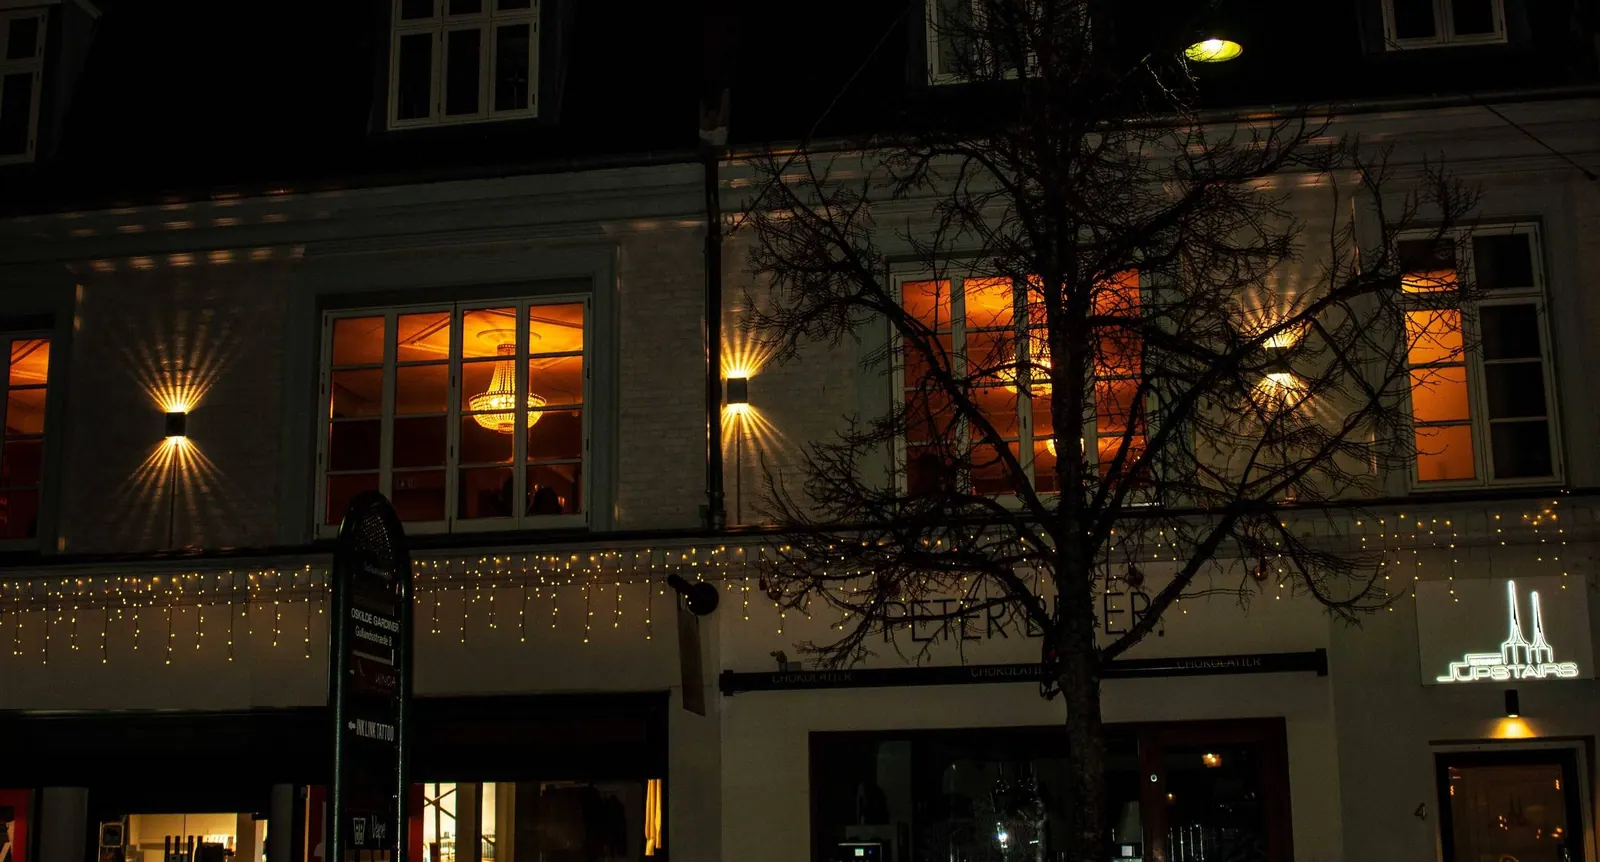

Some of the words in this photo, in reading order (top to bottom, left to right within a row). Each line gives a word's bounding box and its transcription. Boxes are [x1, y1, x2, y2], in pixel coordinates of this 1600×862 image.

[884, 597, 1008, 642] PETER
[1454, 661, 1579, 682] UPSTAIRS
[1414, 802, 1428, 821] 4
